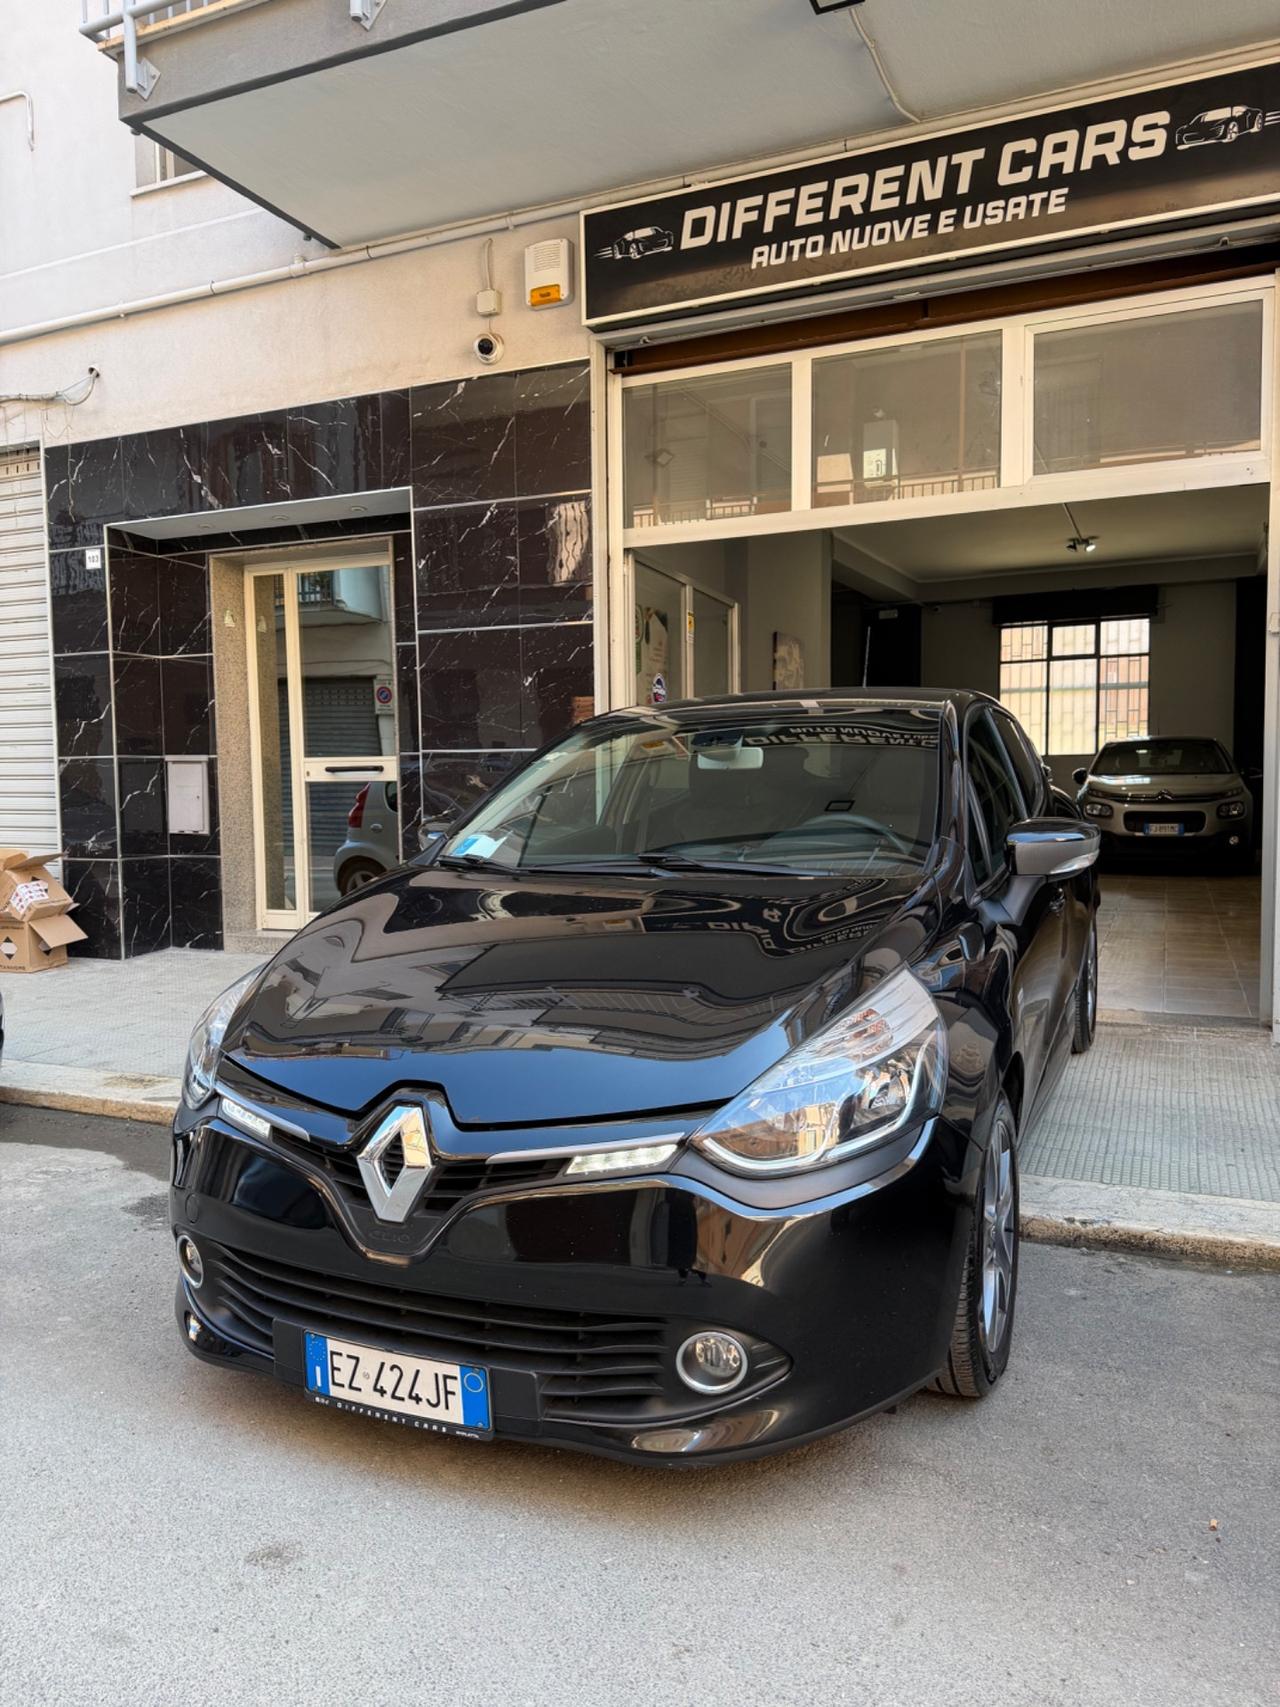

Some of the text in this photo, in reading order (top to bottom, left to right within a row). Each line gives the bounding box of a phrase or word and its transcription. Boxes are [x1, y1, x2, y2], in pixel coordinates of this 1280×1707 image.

[680, 110, 1171, 250] DIFFERENT CARS
[750, 187, 1069, 270] AUTO NUOVE E USATE
[329, 1350, 458, 1411] EZ 424JF
